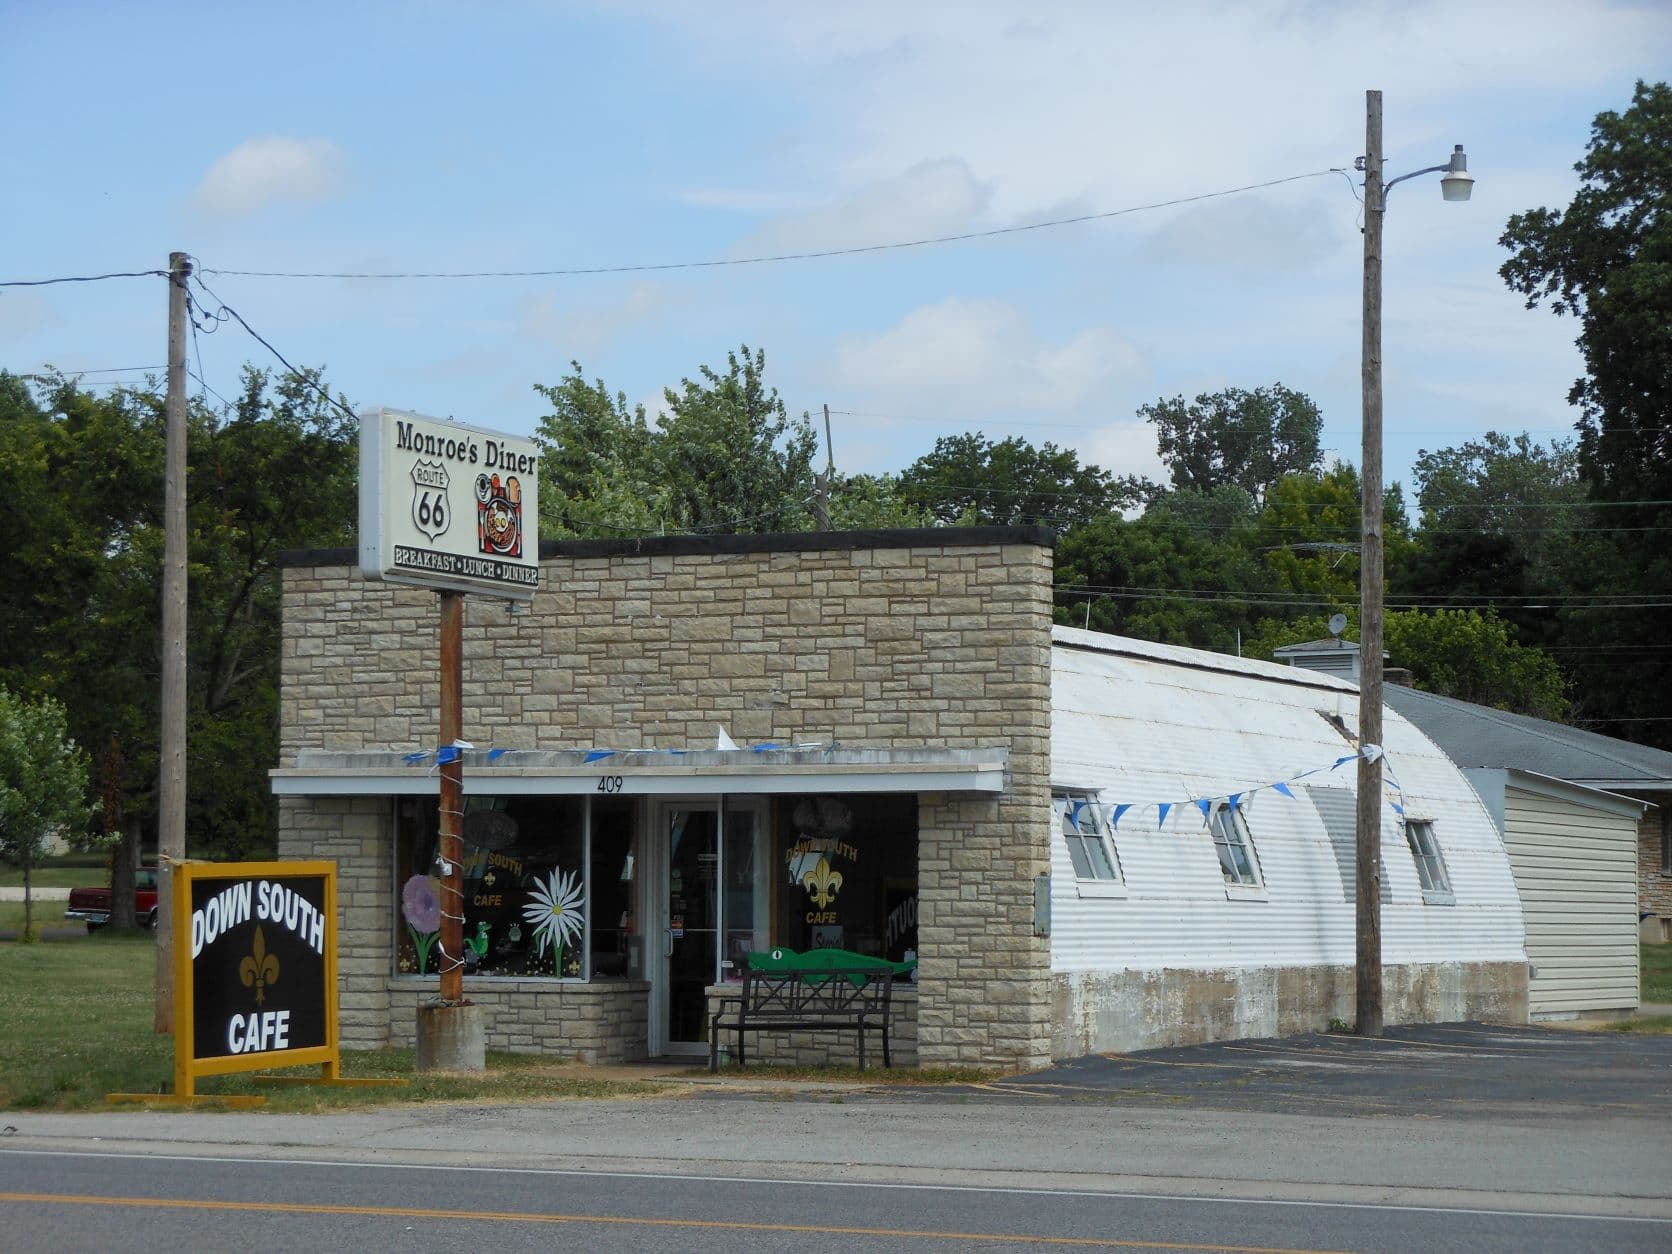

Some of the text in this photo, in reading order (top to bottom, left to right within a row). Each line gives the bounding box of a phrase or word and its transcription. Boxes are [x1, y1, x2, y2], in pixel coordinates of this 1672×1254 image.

[396, 420, 536, 475] Monroe's Diner
[417, 468, 445, 486] ROUTE
[418, 491, 445, 528] 66
[395, 548, 538, 584] BREAKFAST LUNCH DINNER
[597, 776, 623, 792] 409
[488, 853, 523, 875] SOUTH
[473, 895, 503, 906] CAFE
[192, 880, 325, 960] DOWN SOUTH
[806, 912, 837, 924] CAFE
[229, 1010, 290, 1054] CAFE
